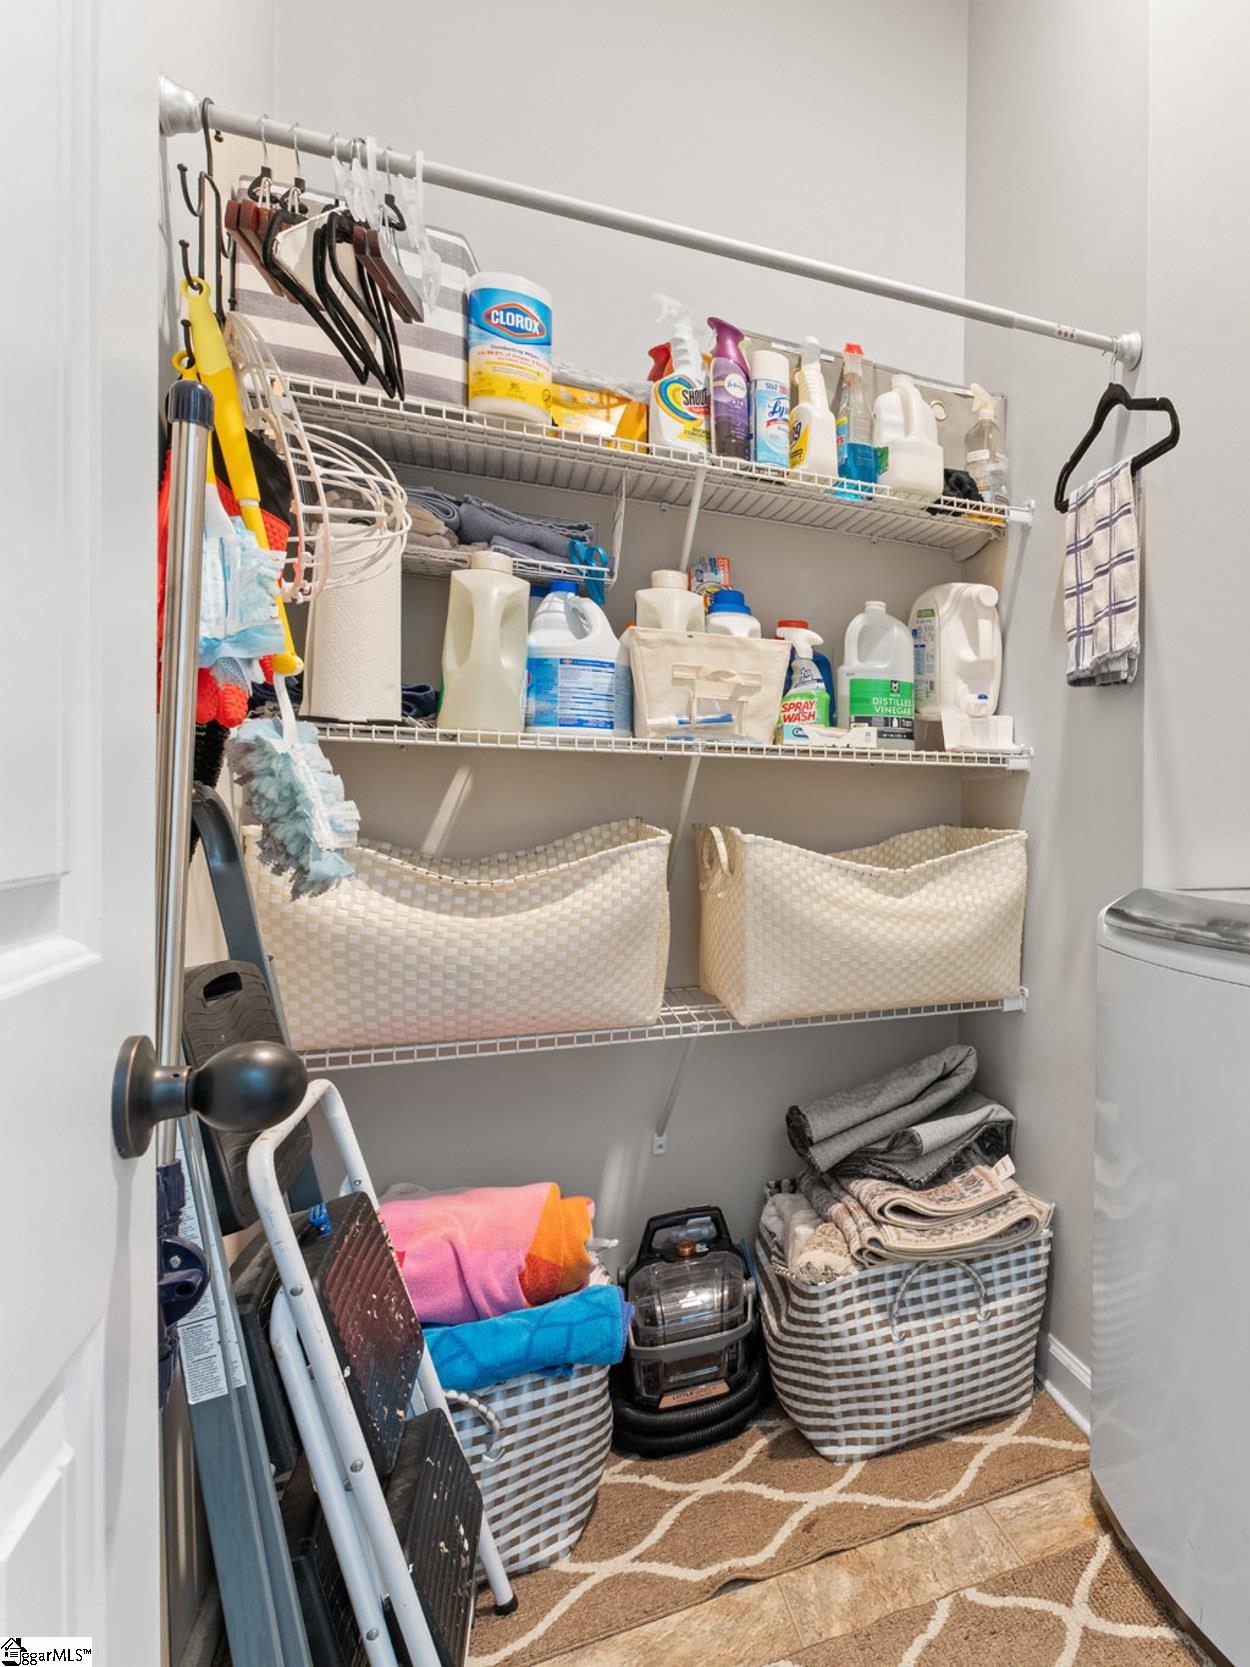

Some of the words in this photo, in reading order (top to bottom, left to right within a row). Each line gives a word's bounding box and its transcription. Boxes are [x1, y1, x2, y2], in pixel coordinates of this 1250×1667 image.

[490, 309, 540, 334] CLOROX
[781, 700, 815, 712] SPRAY
[783, 712, 816, 723] WASH
